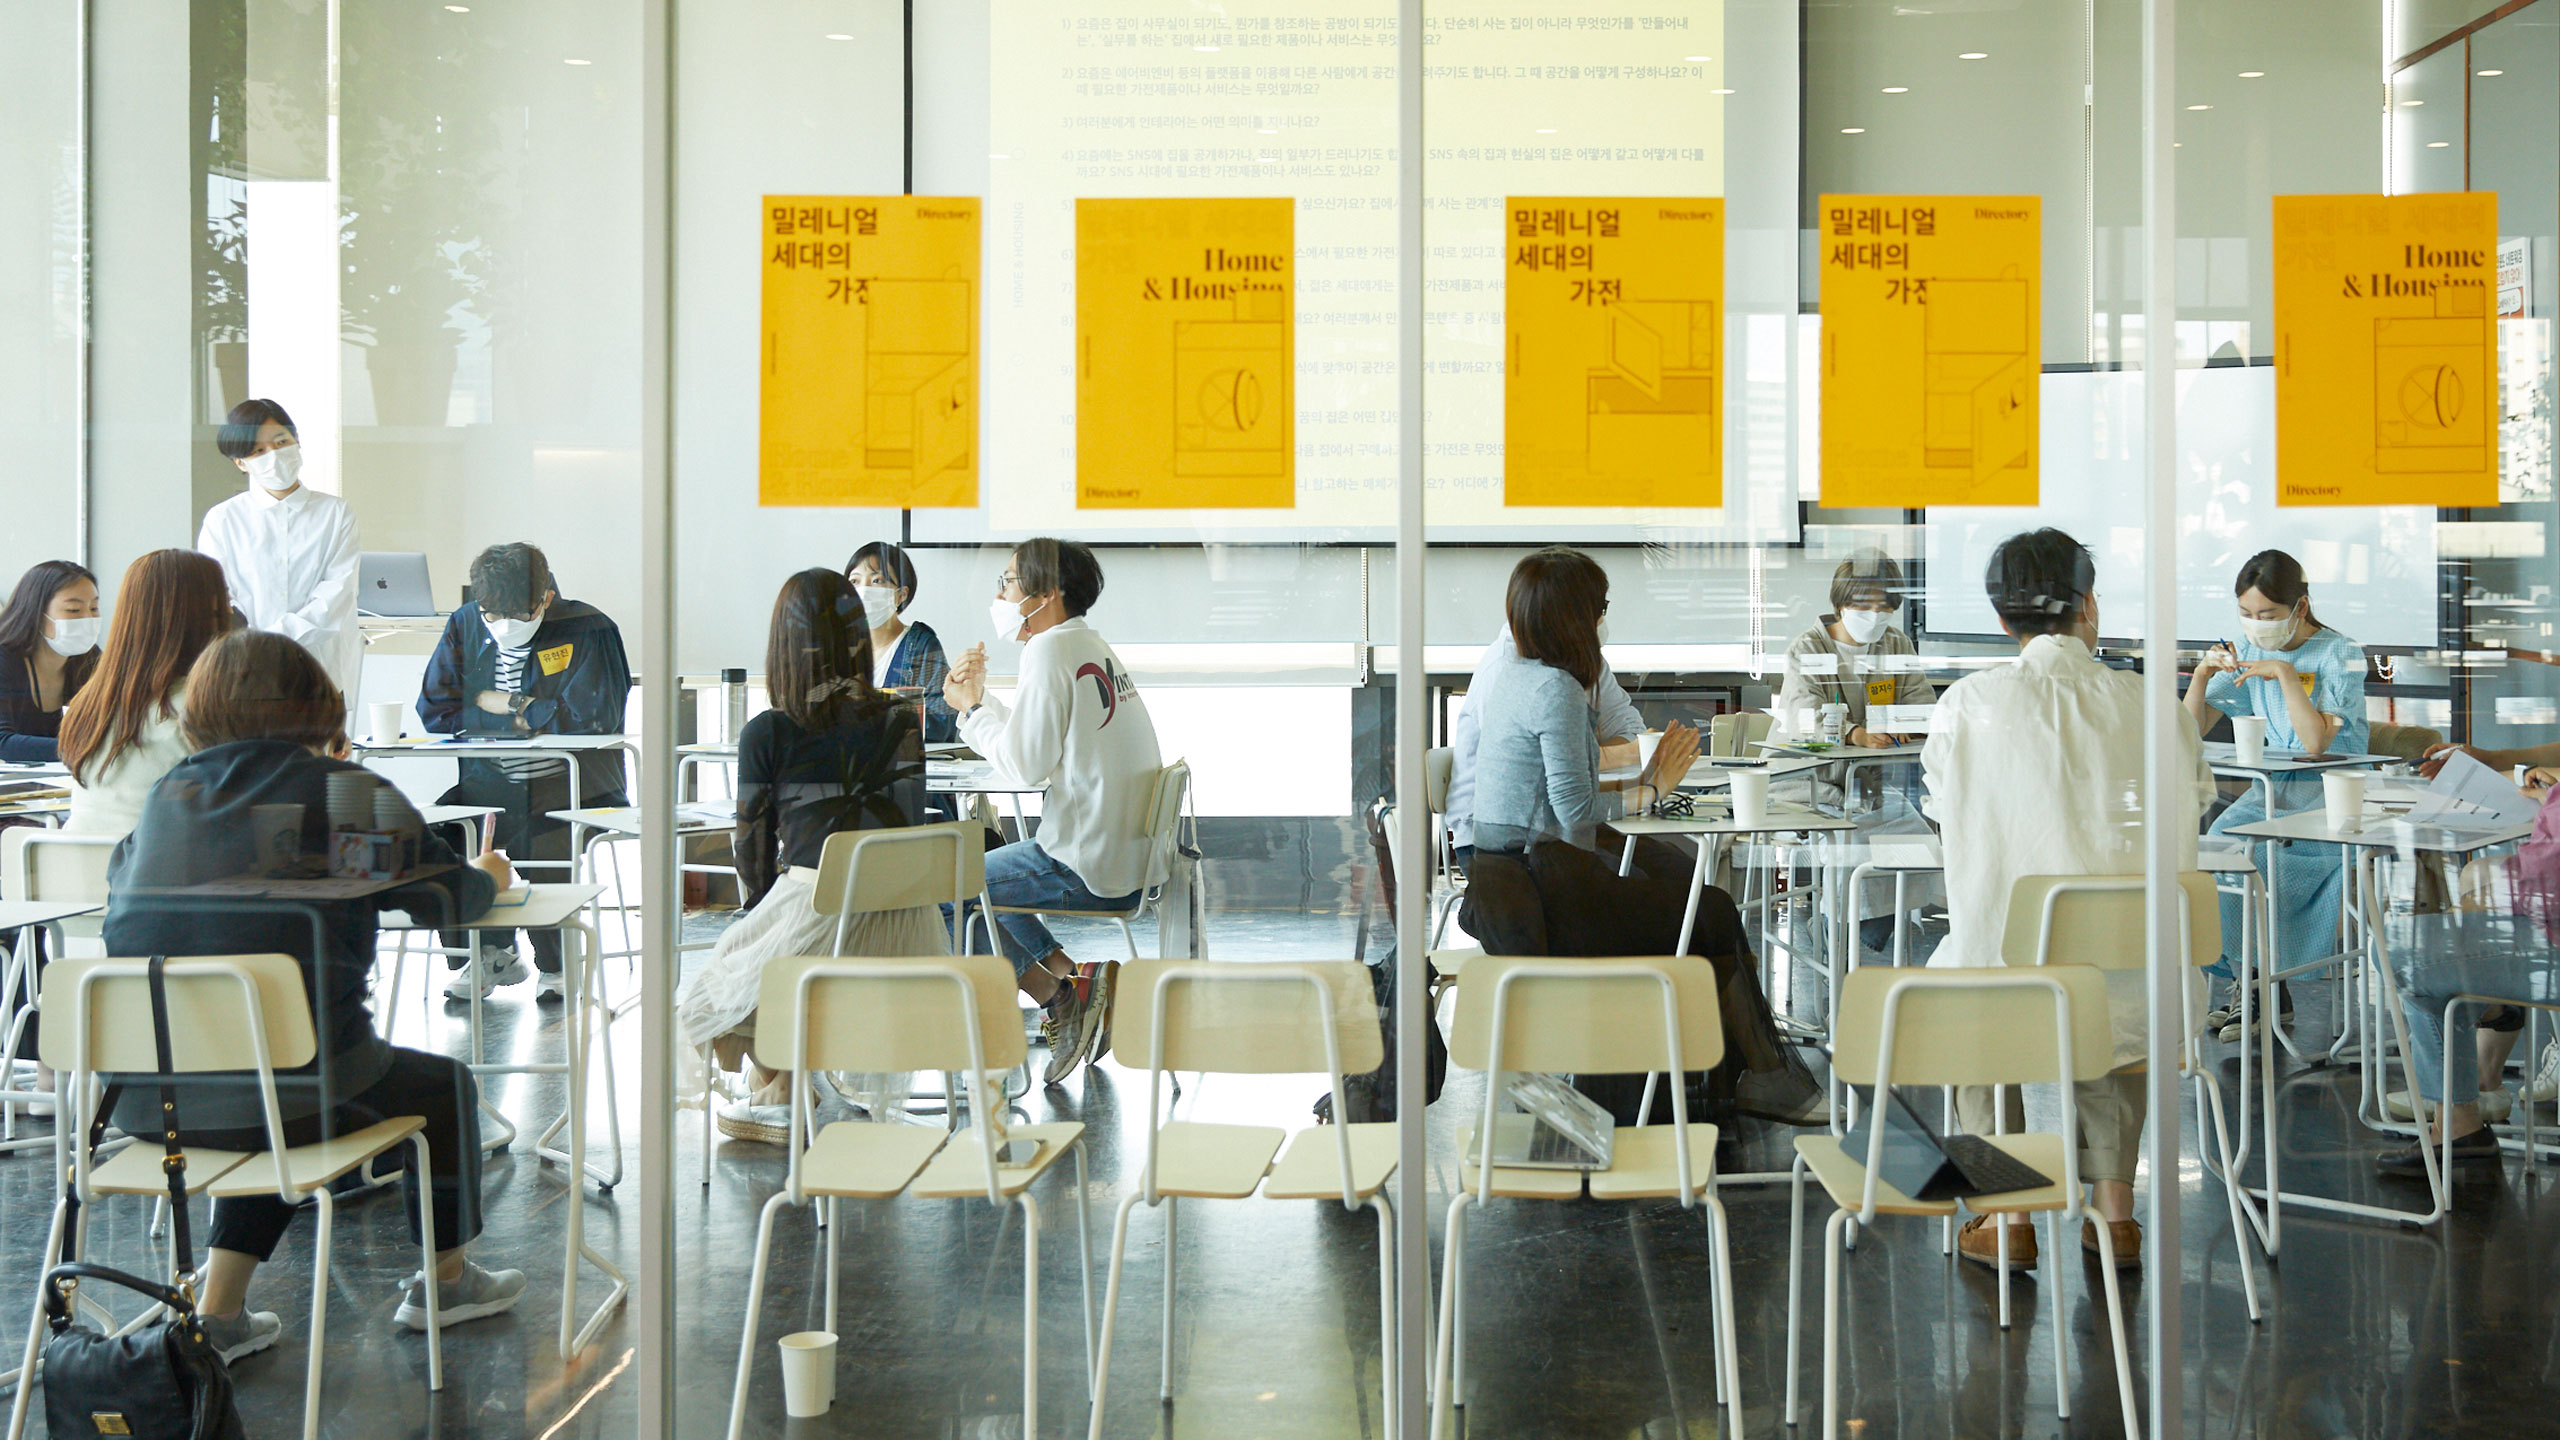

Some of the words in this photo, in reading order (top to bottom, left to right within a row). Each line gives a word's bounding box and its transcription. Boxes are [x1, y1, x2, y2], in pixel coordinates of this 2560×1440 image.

[1077, 17, 1112, 31] 요즘은
[1115, 17, 1139, 31] 집이
[1143, 17, 1189, 31] 사무실이
[1274, 17, 1321, 31] 창조하는
[1325, 17, 1359, 31] 공방이
[1445, 17, 1479, 31] 단순히
[1483, 17, 1506, 31] 사는
[1510, 17, 1533, 31] 집이
[1537, 17, 1572, 31] 아니라
[1575, 17, 1634, 31] 무엇인가를
[1171, 33, 1206, 47] 집에서
[1238, 33, 1272, 47] 필요한
[1276, 33, 1322, 47] 제품이나
[1326, 33, 1373, 47] 서비스는
[1077, 66, 1112, 80] 요즘은
[1178, 66, 1202, 80] 등의
[1205, 66, 1251, 80] 플랫폼을
[1256, 66, 1290, 80] 이용해
[1294, 66, 1318, 80] 다른
[1321, 66, 1368, 80] 사람에게
[1473, 66, 1511, 80] 합니다.
[1515, 66, 1527, 80] 그
[1530, 66, 1542, 80] 때
[1545, 66, 1580, 80] 공간을
[1584, 66, 1619, 80] 어떻게
[1622, 66, 1687, 80] 구성하나요?
[1691, 66, 1703, 80] 이
[1076, 83, 1088, 97] 때
[1092, 83, 1127, 97] 필요한
[1130, 83, 1202, 97] 가전제품이나
[1205, 83, 1252, 97] 서비스는
[1255, 83, 1320, 97] 무엇일까요?
[1077, 115, 1136, 129] 여러분에게
[1139, 115, 1198, 129] 인테리어는
[1201, 115, 1225, 129] 어떤
[1228, 115, 1264, 129] 의미를
[1077, 148, 1124, 162] 요즘에는
[1127, 148, 1163, 162] SNS에
[1167, 148, 1190, 162] 집을
[1286, 148, 1322, 162] 일부가
[1325, 148, 1384, 162] 드러나기도
[1429, 148, 1454, 162] SNS
[1457, 148, 1480, 162] 속의
[1484, 148, 1507, 162] 집과
[1511, 148, 1546, 162] 현실의
[1549, 148, 1573, 162] 집은
[1576, 148, 1612, 162] 어떻게
[1642, 148, 1677, 162] 어떻게
[1681, 148, 1704, 162] 다를
[1110, 164, 1134, 179] SNS
[1138, 164, 1172, 179] 시대에
[1176, 164, 1212, 179] 필요한
[1214, 164, 1285, 179] 가전제품이나
[1288, 164, 1334, 179] 서비스도
[1338, 164, 1381, 179] 있나요?
[1302, 198, 1366, 210] 싶으신가요?
[1439, 198, 1461, 210] 사는
[772, 206, 878, 236] 밀레니얼
[917, 207, 972, 221] Directory
[1659, 209, 1714, 222] Directory
[1975, 207, 2030, 221] Directory
[1515, 209, 1620, 237] 밀레니얼
[1830, 207, 1936, 236] 밀레니얼
[771, 242, 851, 269] 세대의
[1205, 248, 1284, 272] Home
[1333, 247, 1367, 259] 필요한
[1433, 247, 1457, 259] 따로
[1461, 247, 1496, 259] 있다고
[1515, 245, 1593, 272] 세대의
[1830, 242, 1909, 270] 세대의
[2405, 244, 2486, 268] Home
[1144, 278, 1162, 301] &
[1570, 279, 1621, 306] 가전
[2343, 273, 2362, 298] &
[1361, 362, 1396, 375] 공간은
[1438, 362, 1492, 375] 변할까요?
[1352, 411, 1377, 424] 어떤
[1319, 444, 1354, 457] 집에서
[1436, 444, 1471, 457] 가전은
[1085, 487, 1140, 501] Directory
[2286, 484, 2342, 499] Directory
